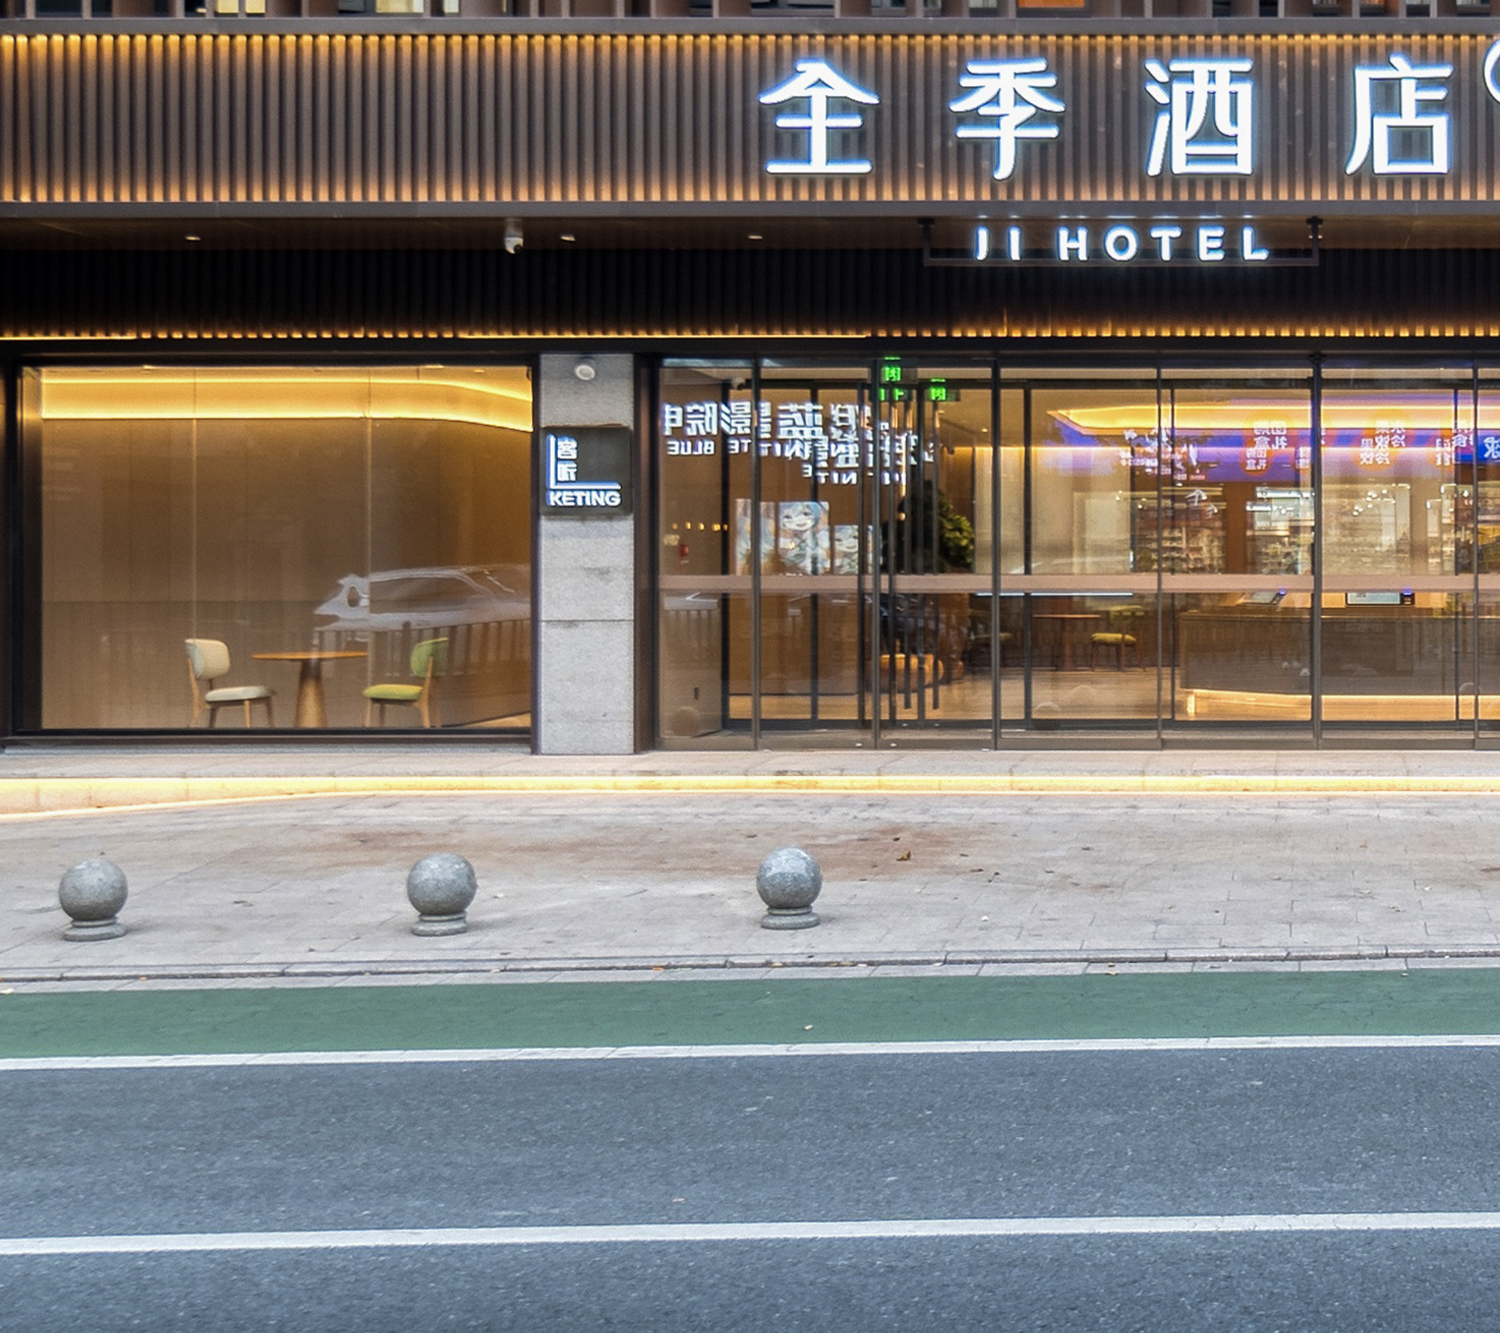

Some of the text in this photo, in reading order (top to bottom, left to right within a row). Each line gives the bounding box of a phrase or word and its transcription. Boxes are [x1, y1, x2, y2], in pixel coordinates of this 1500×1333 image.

[758, 53, 1454, 181] 全季酒店
[974, 225, 1270, 261] JI HOTEL
[547, 490, 622, 507] KETING
